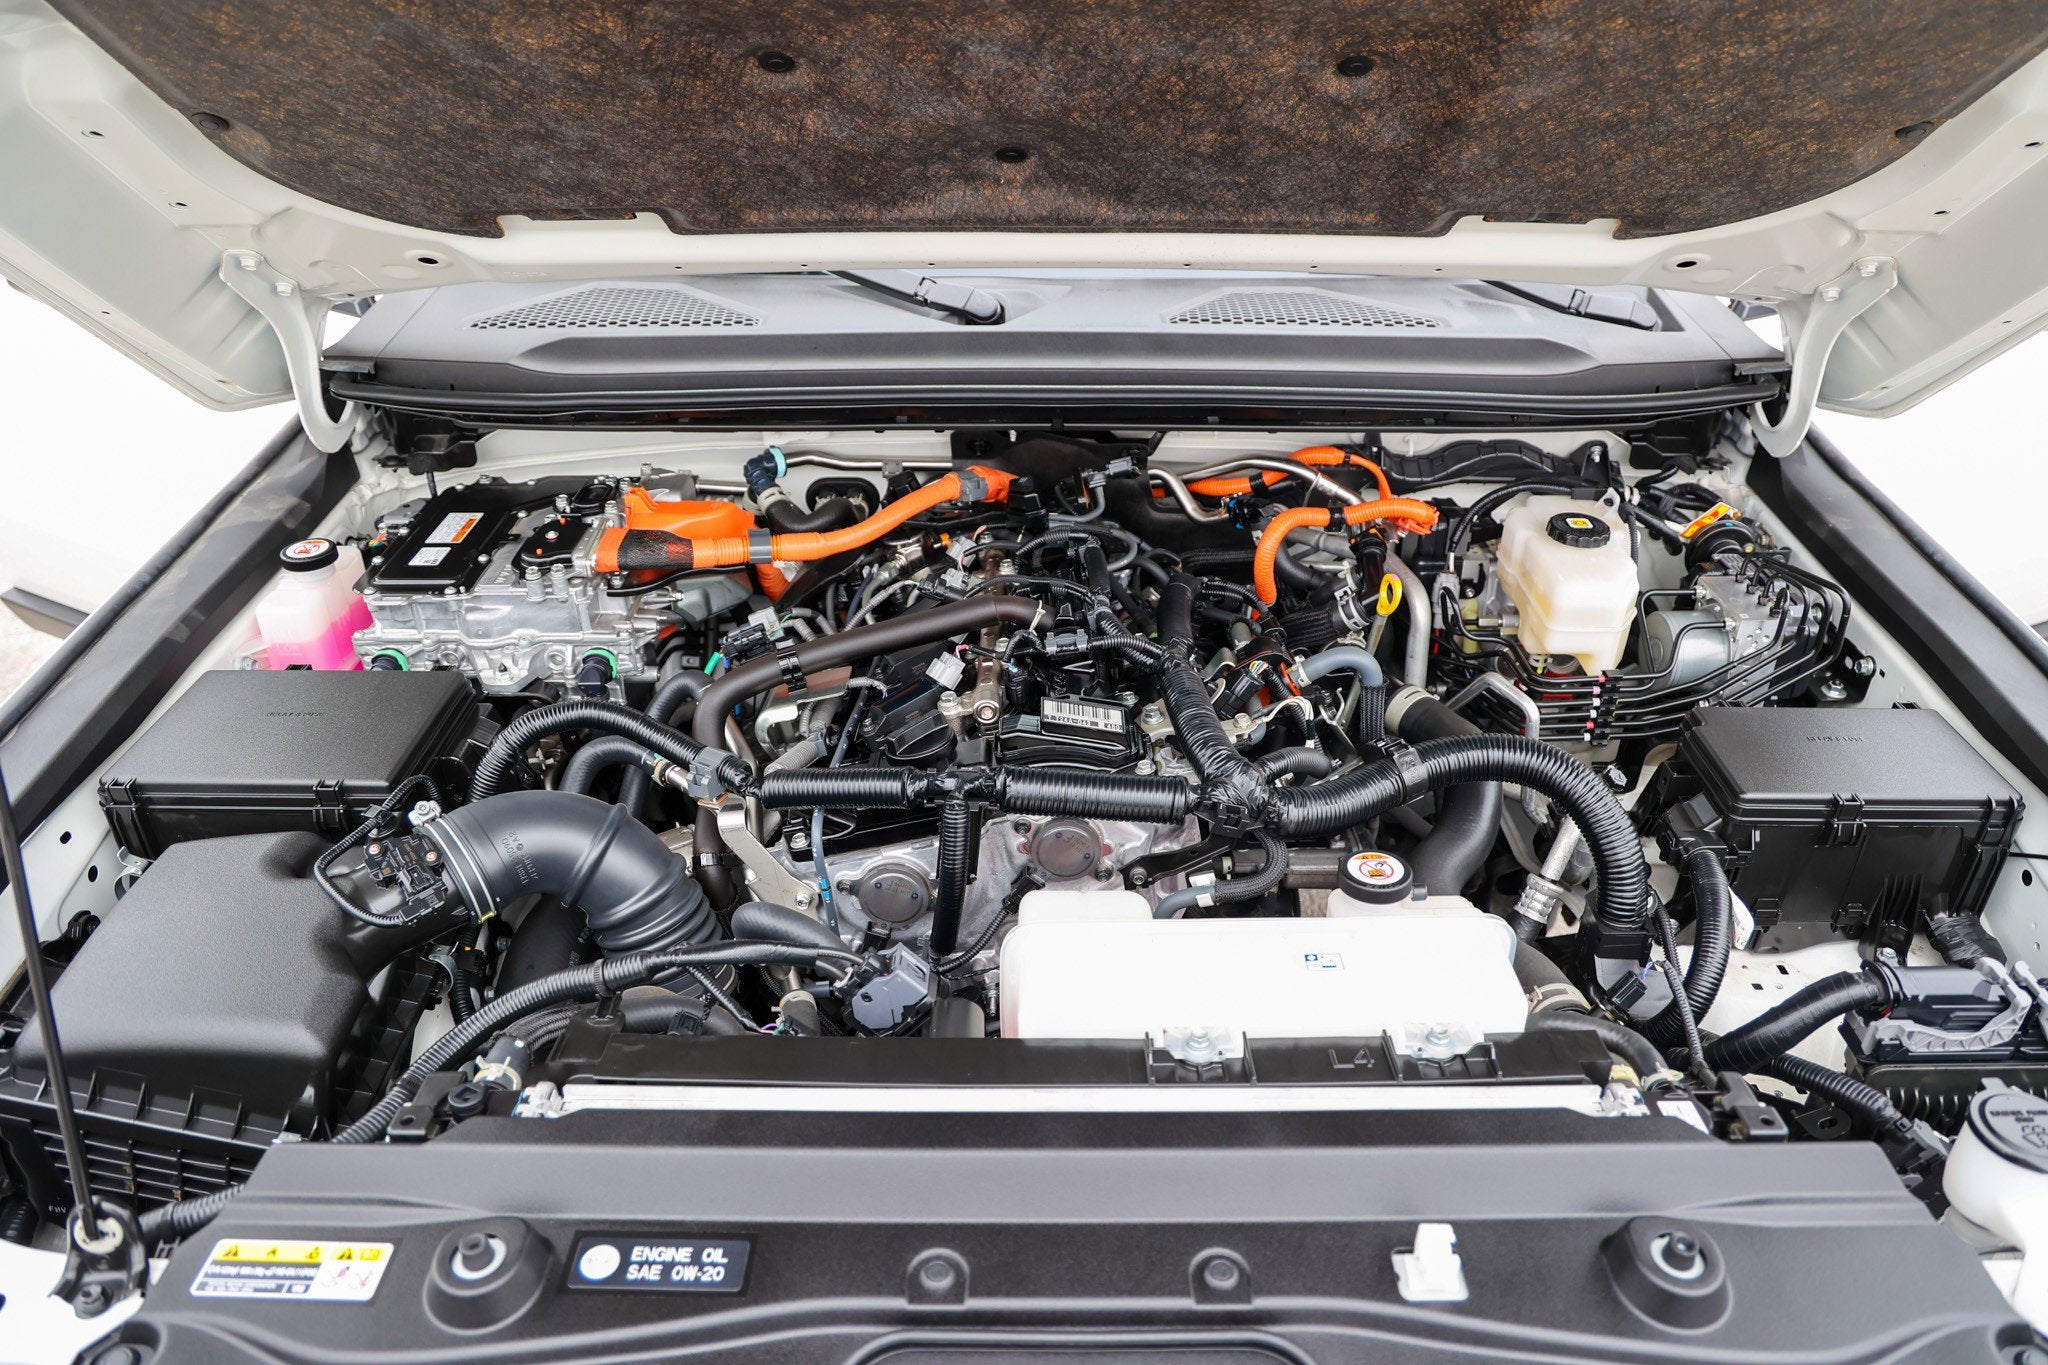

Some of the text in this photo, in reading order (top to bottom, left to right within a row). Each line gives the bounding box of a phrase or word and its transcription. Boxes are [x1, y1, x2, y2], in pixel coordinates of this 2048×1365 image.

[1329, 1048, 1375, 1069] L4
[630, 1245, 729, 1263] ENGINE OIL
[626, 1264, 726, 1282] SAE 0W-20
